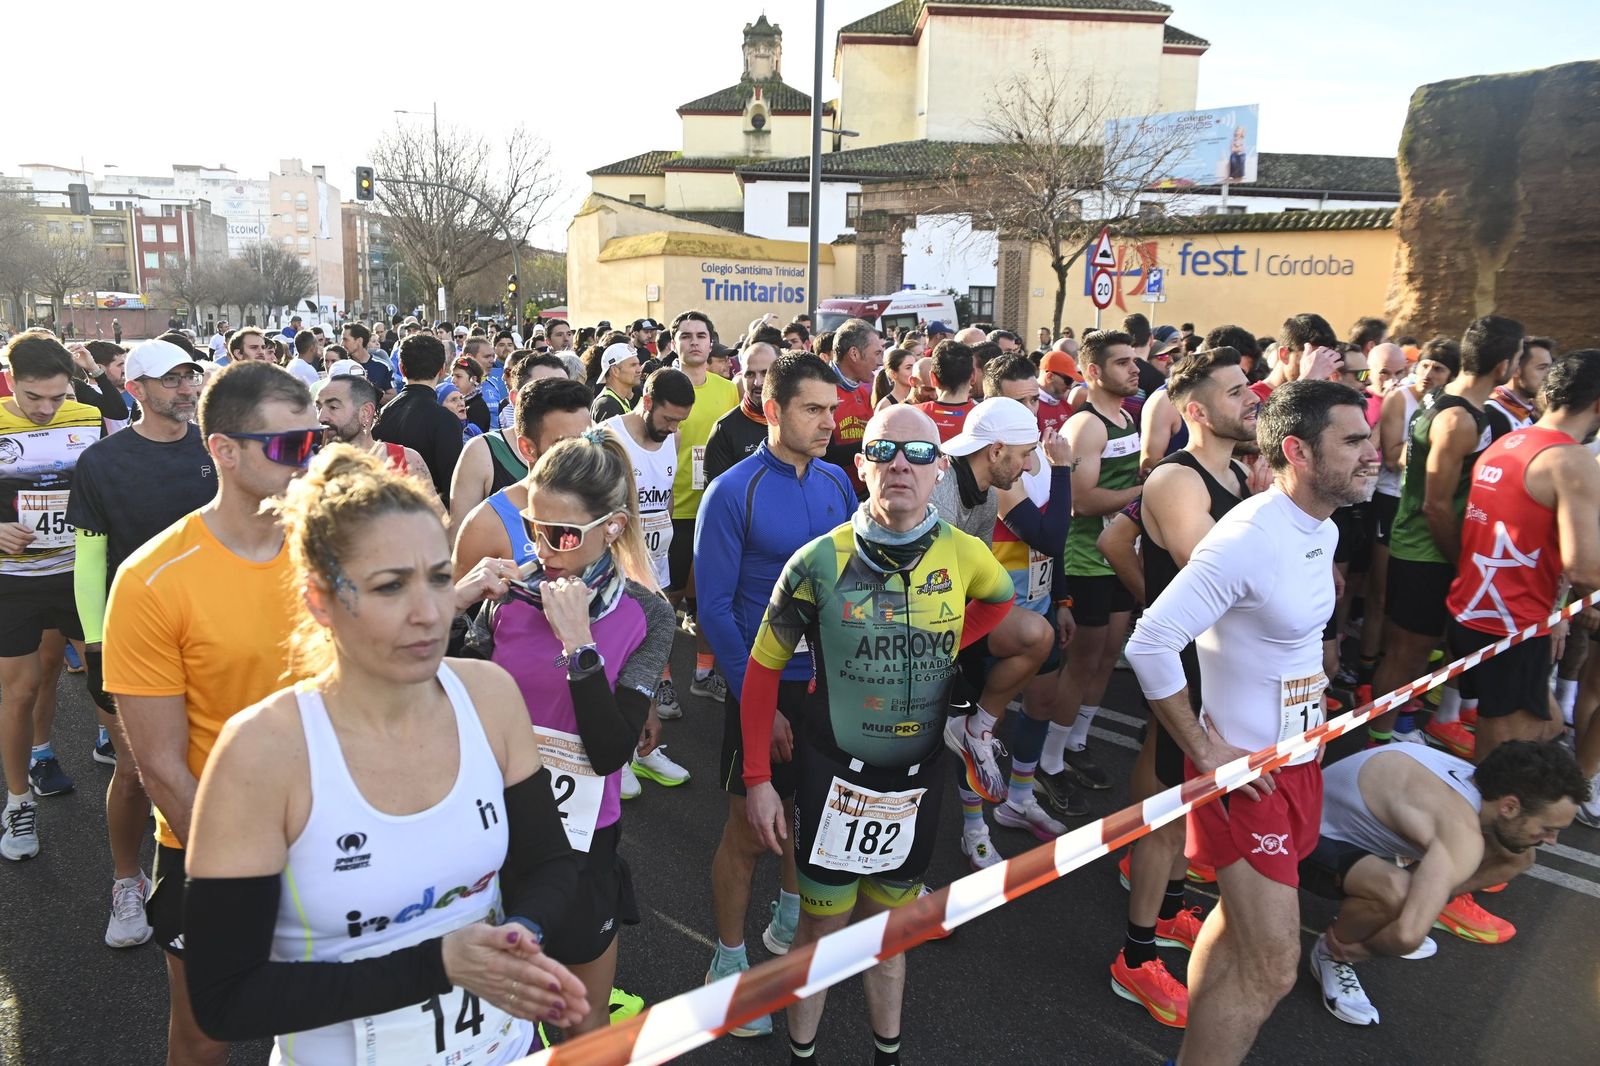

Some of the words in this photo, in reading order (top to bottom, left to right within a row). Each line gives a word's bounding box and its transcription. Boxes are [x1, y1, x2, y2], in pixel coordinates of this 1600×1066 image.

[1177, 113, 1213, 124] Colegio
[701, 262, 733, 275] Colegio
[774, 266, 805, 278] Trinidad
[1178, 242, 1248, 276] fest
[1267, 254, 1354, 277] Córdoba
[702, 278, 805, 304] Trinitarios
[1097, 282, 1110, 296] 20
[23, 495, 48, 511] XLII
[855, 630, 956, 661] ARROYO
[844, 819, 901, 855] 182
[421, 988, 484, 1054] 14
